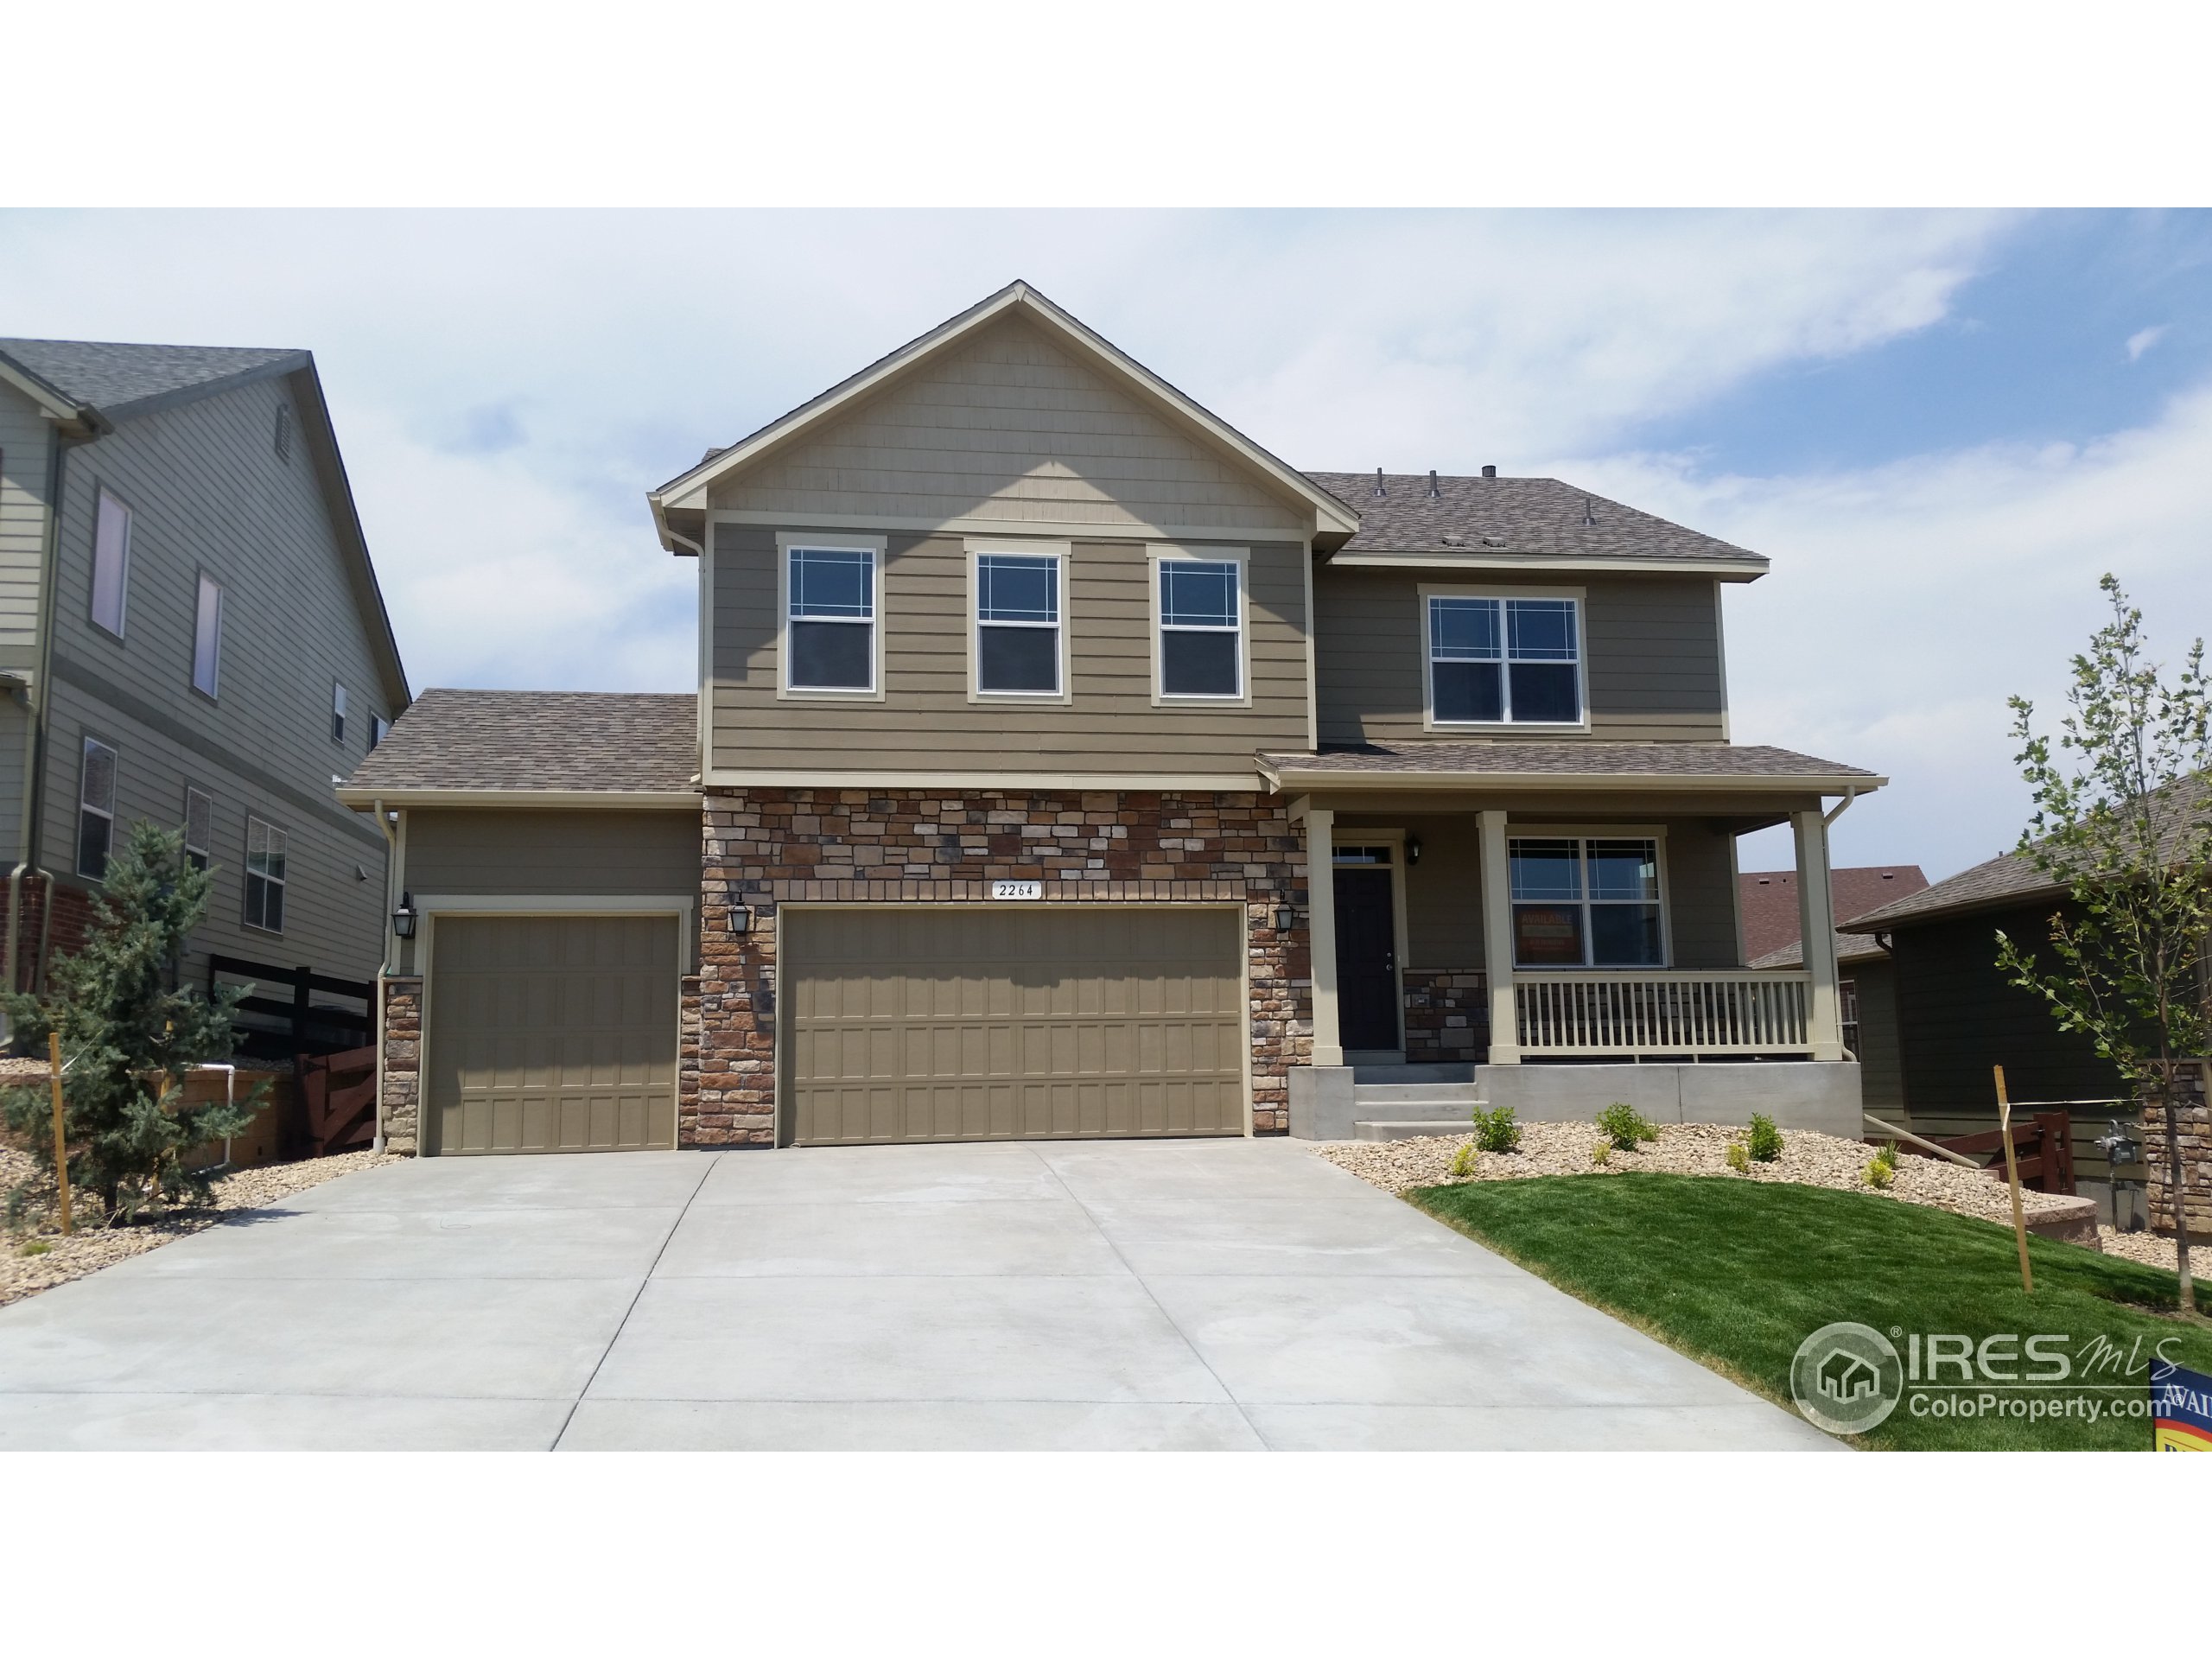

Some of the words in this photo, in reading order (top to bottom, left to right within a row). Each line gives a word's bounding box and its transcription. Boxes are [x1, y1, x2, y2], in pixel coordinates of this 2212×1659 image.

[999, 884, 1033, 896] 2264
[1522, 914, 1573, 925] AVAILABLE
[2162, 1382, 2212, 1419] AVAI
